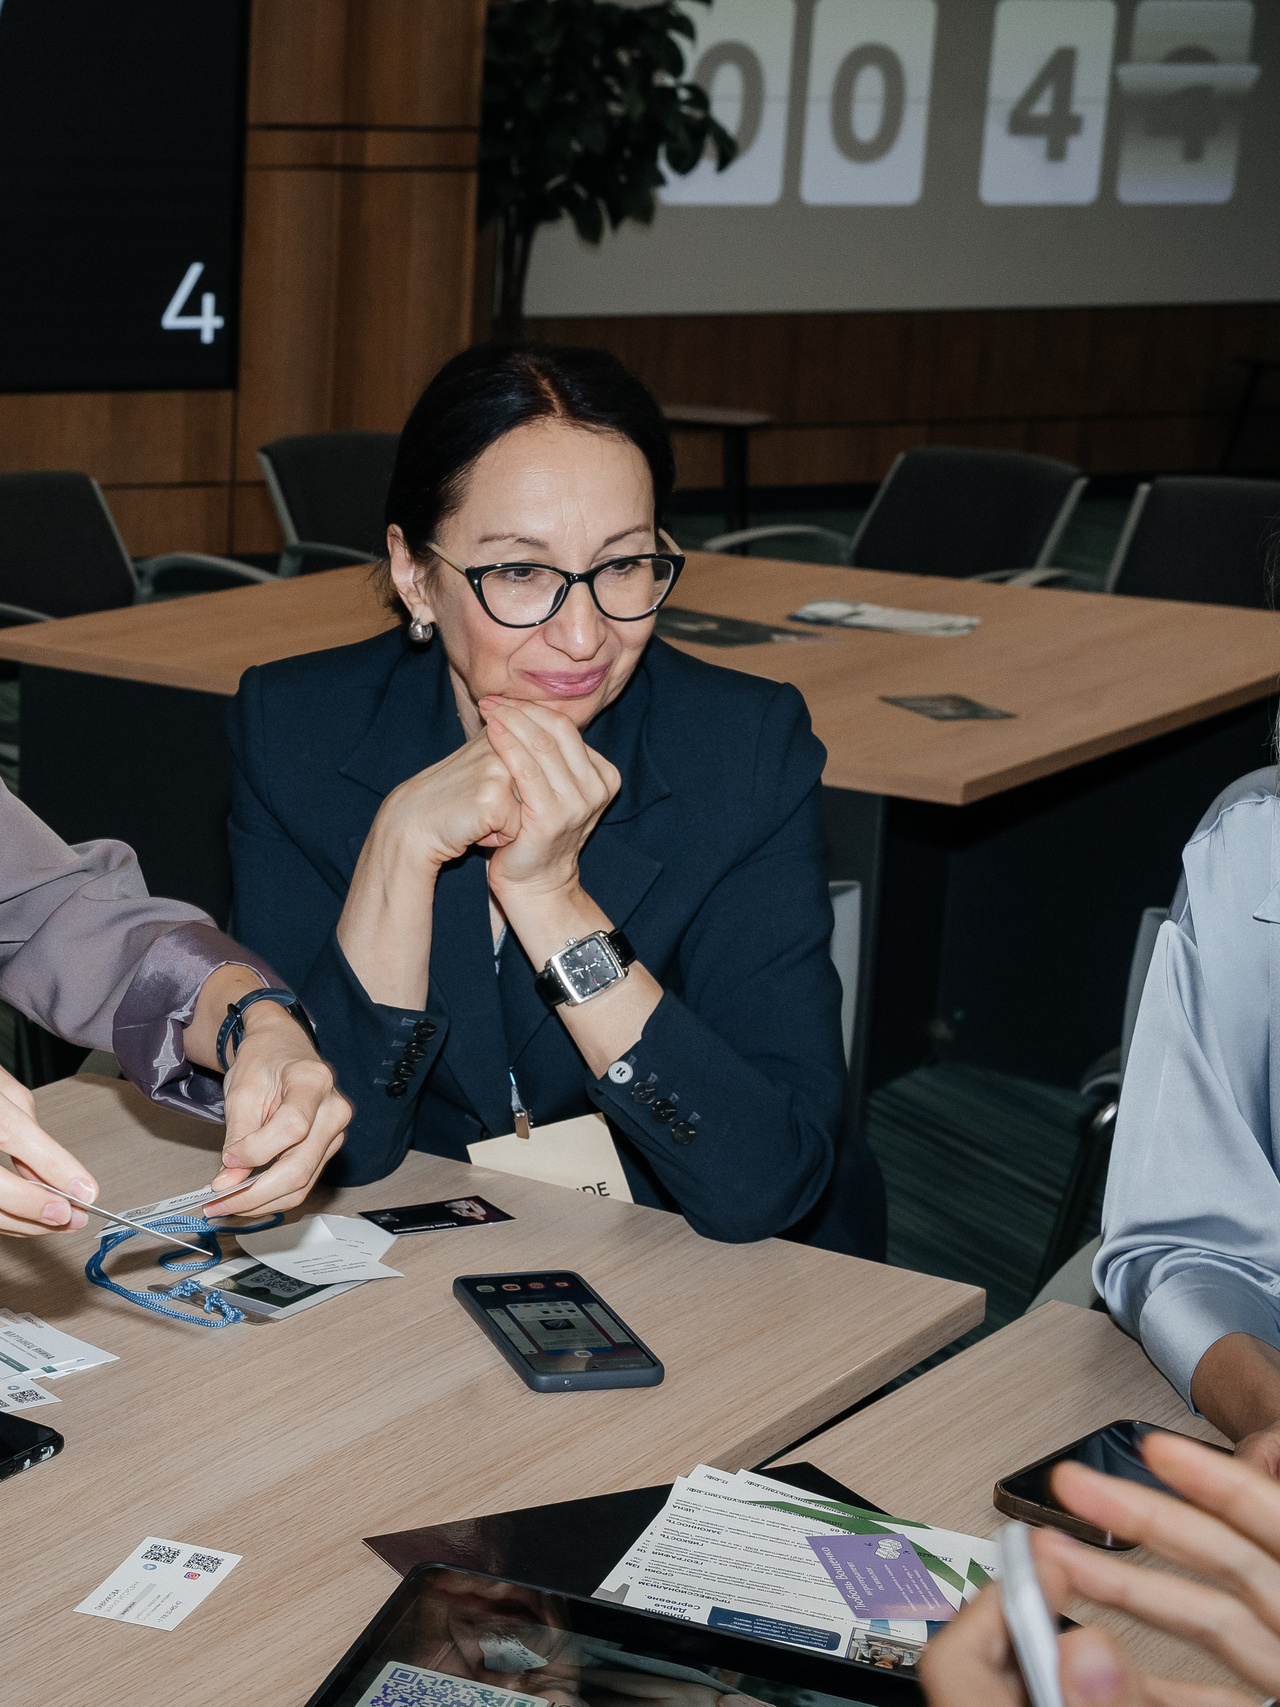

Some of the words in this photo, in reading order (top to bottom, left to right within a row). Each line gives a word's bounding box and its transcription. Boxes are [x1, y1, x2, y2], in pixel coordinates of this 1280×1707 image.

[161, 262, 224, 345] 4
[670, 1504, 695, 1513] ЦЕНА
[663, 1518, 723, 1535] ЗАКОННОСТЬ
[658, 1533, 704, 1546] ГИБКОСТЬ
[650, 1550, 704, 1565] ГЕОГРАФИЯ
[817, 1546, 849, 1579] Вощенко
[643, 1567, 674, 1577] СРОКИ
[845, 1561, 877, 1595] игротерапевт
[863, 1566, 886, 1590] психолог
[636, 1580, 731, 1604] ПРОФЕССИОНАЛИЗМ
[838, 1580, 869, 1611] Любовь
[642, 1593, 701, 1611] Сергеевне.
[652, 1601, 687, 1613] Дарье
